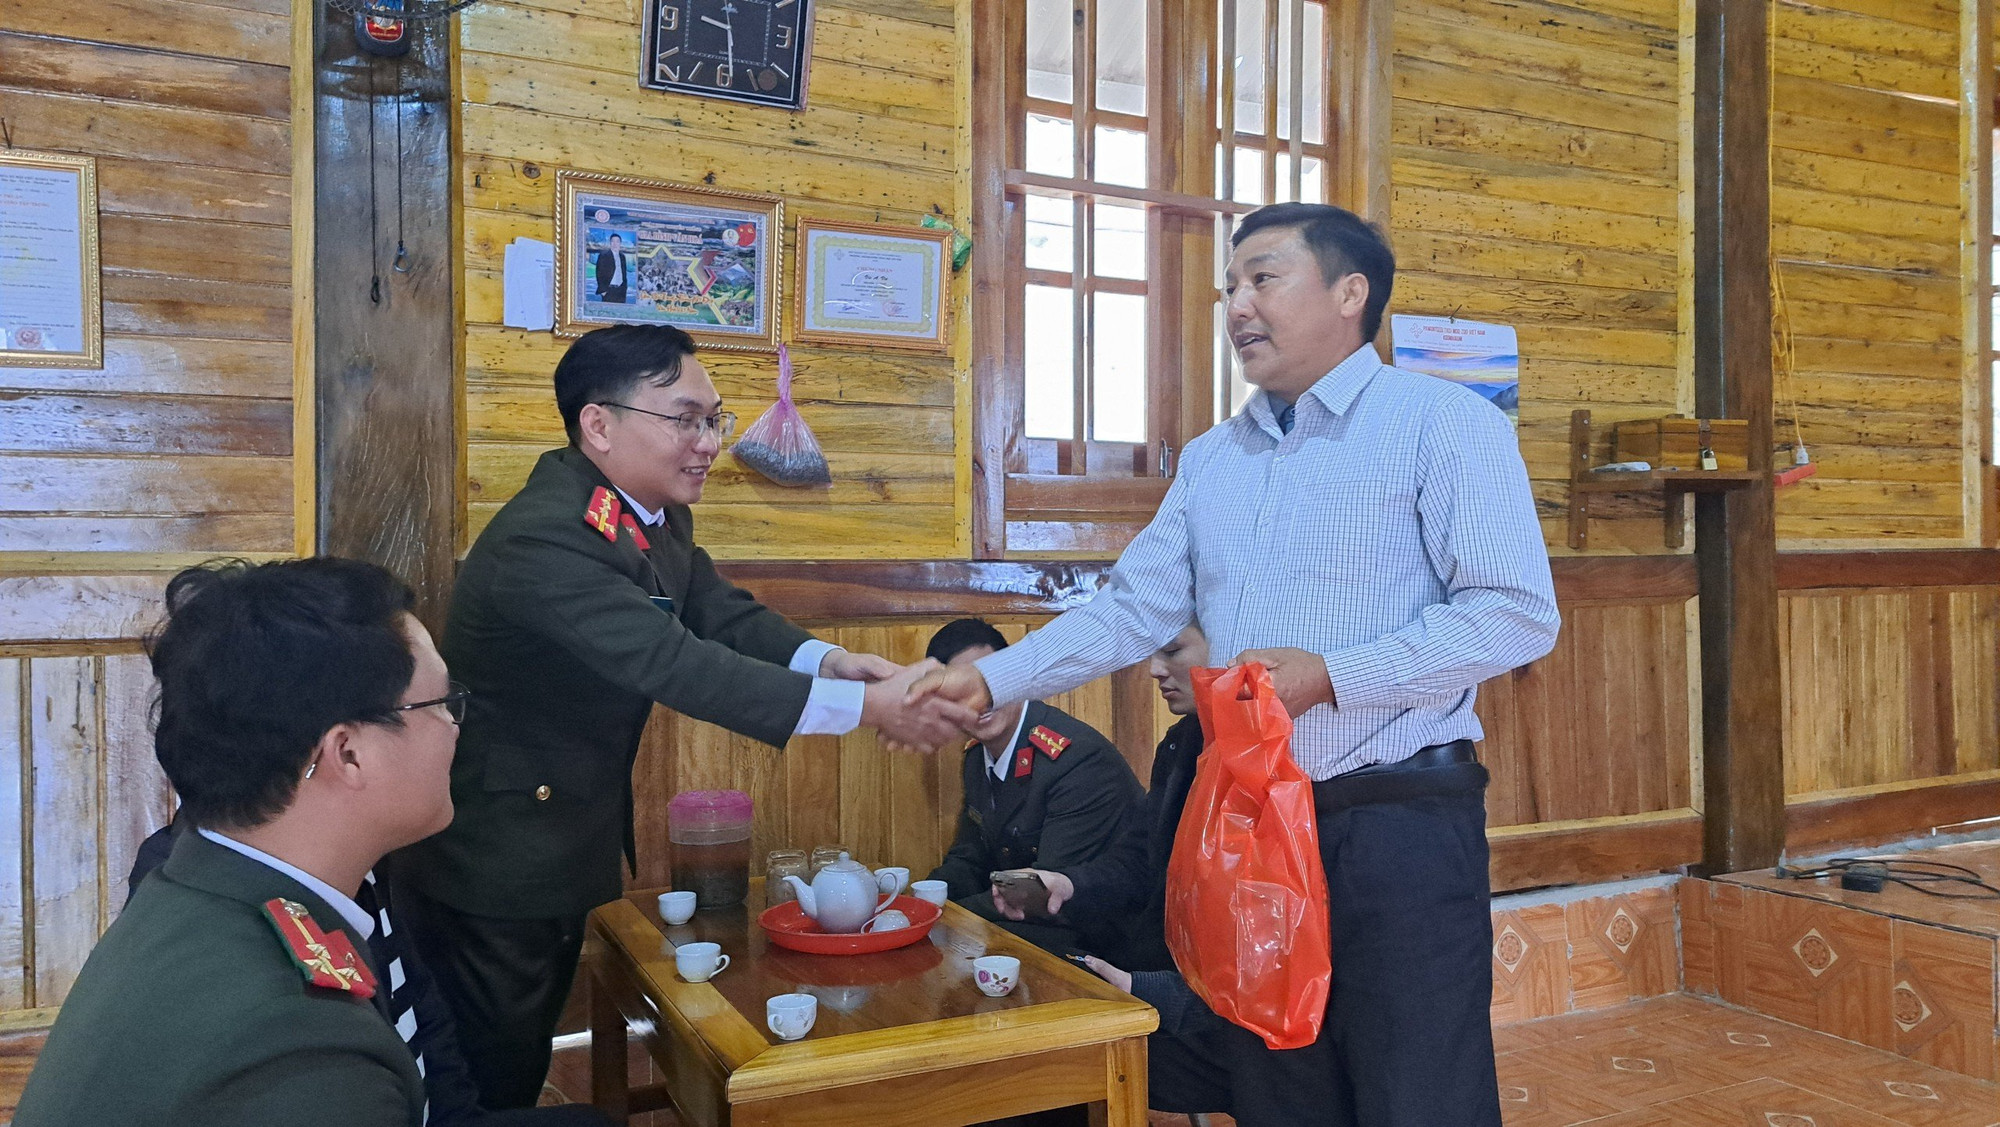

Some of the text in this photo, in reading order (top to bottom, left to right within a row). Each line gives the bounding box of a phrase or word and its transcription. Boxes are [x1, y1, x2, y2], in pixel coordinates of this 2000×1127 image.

[661, 5, 679, 31] 9
[776, 24, 792, 49] 3
[716, 63, 733, 88] 6
